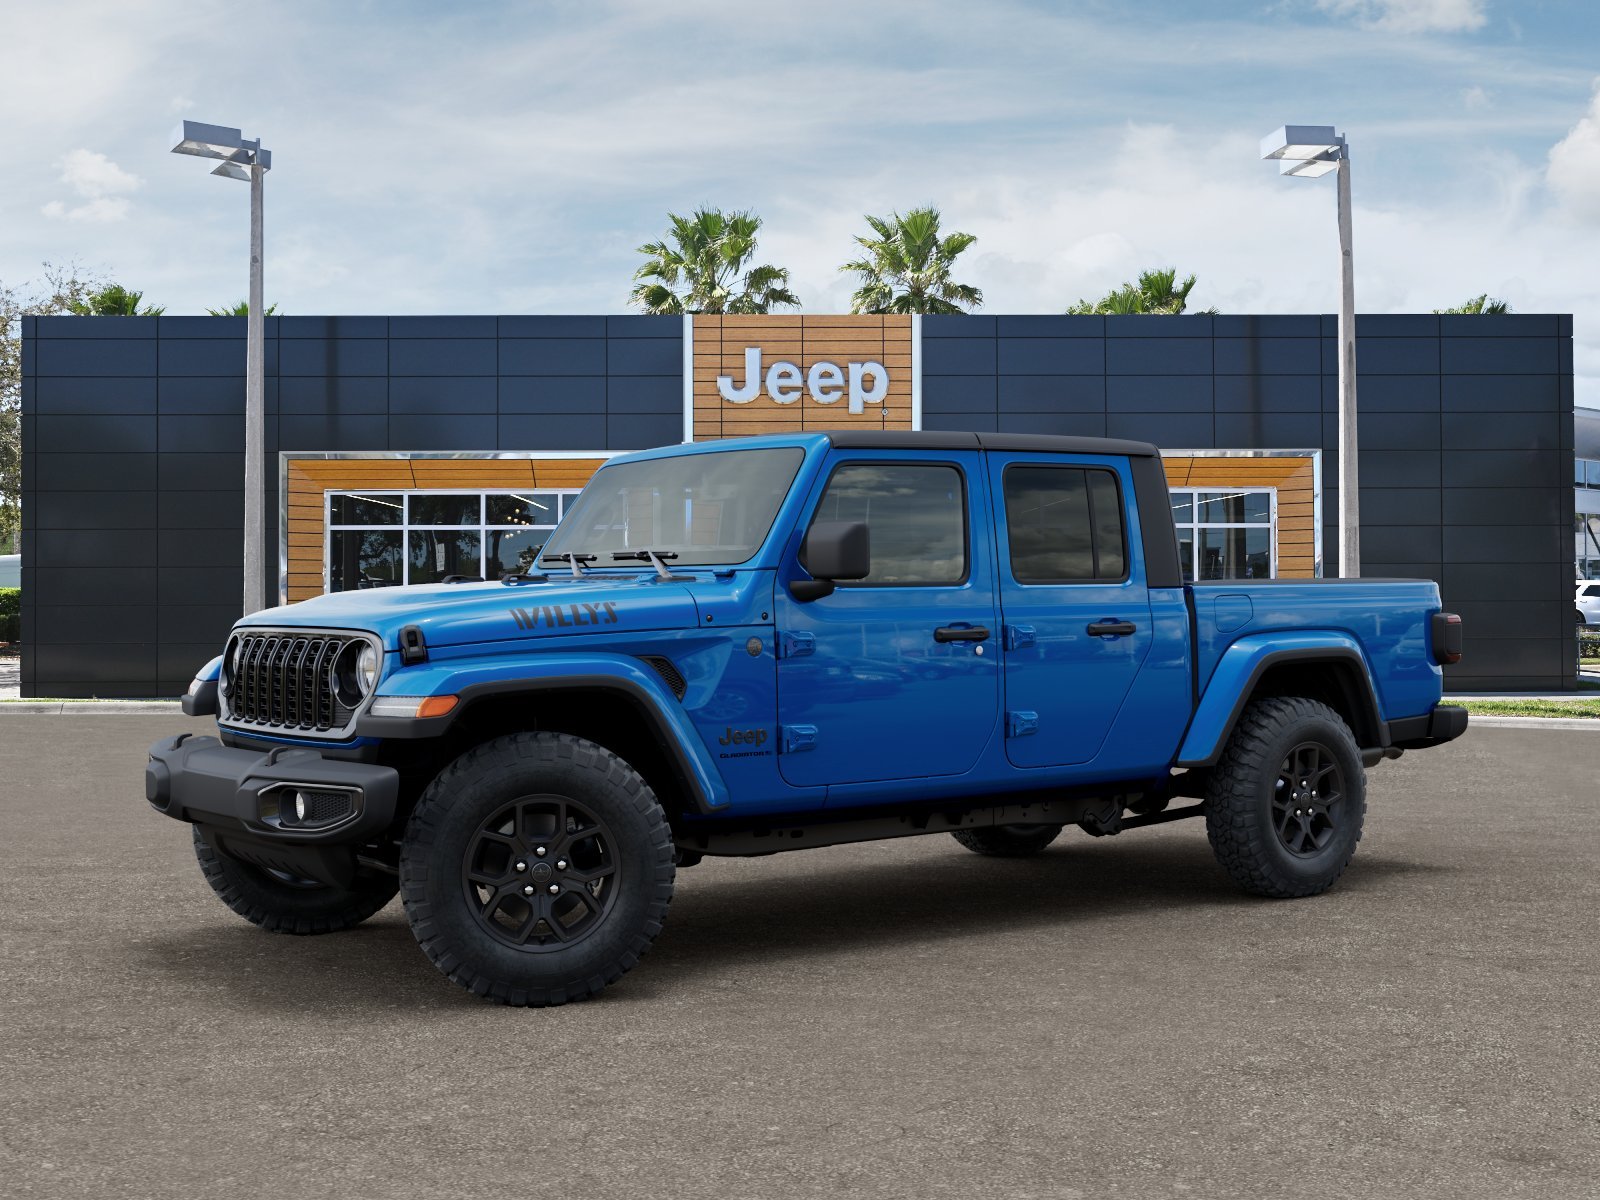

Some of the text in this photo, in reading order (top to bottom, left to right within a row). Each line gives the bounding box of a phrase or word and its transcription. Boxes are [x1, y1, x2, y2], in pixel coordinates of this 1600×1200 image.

[716, 346, 890, 415] Jeep
[508, 601, 618, 630] WILLYS
[718, 726, 768, 747] Jeep
[719, 750, 765, 759] GLADIATOR
